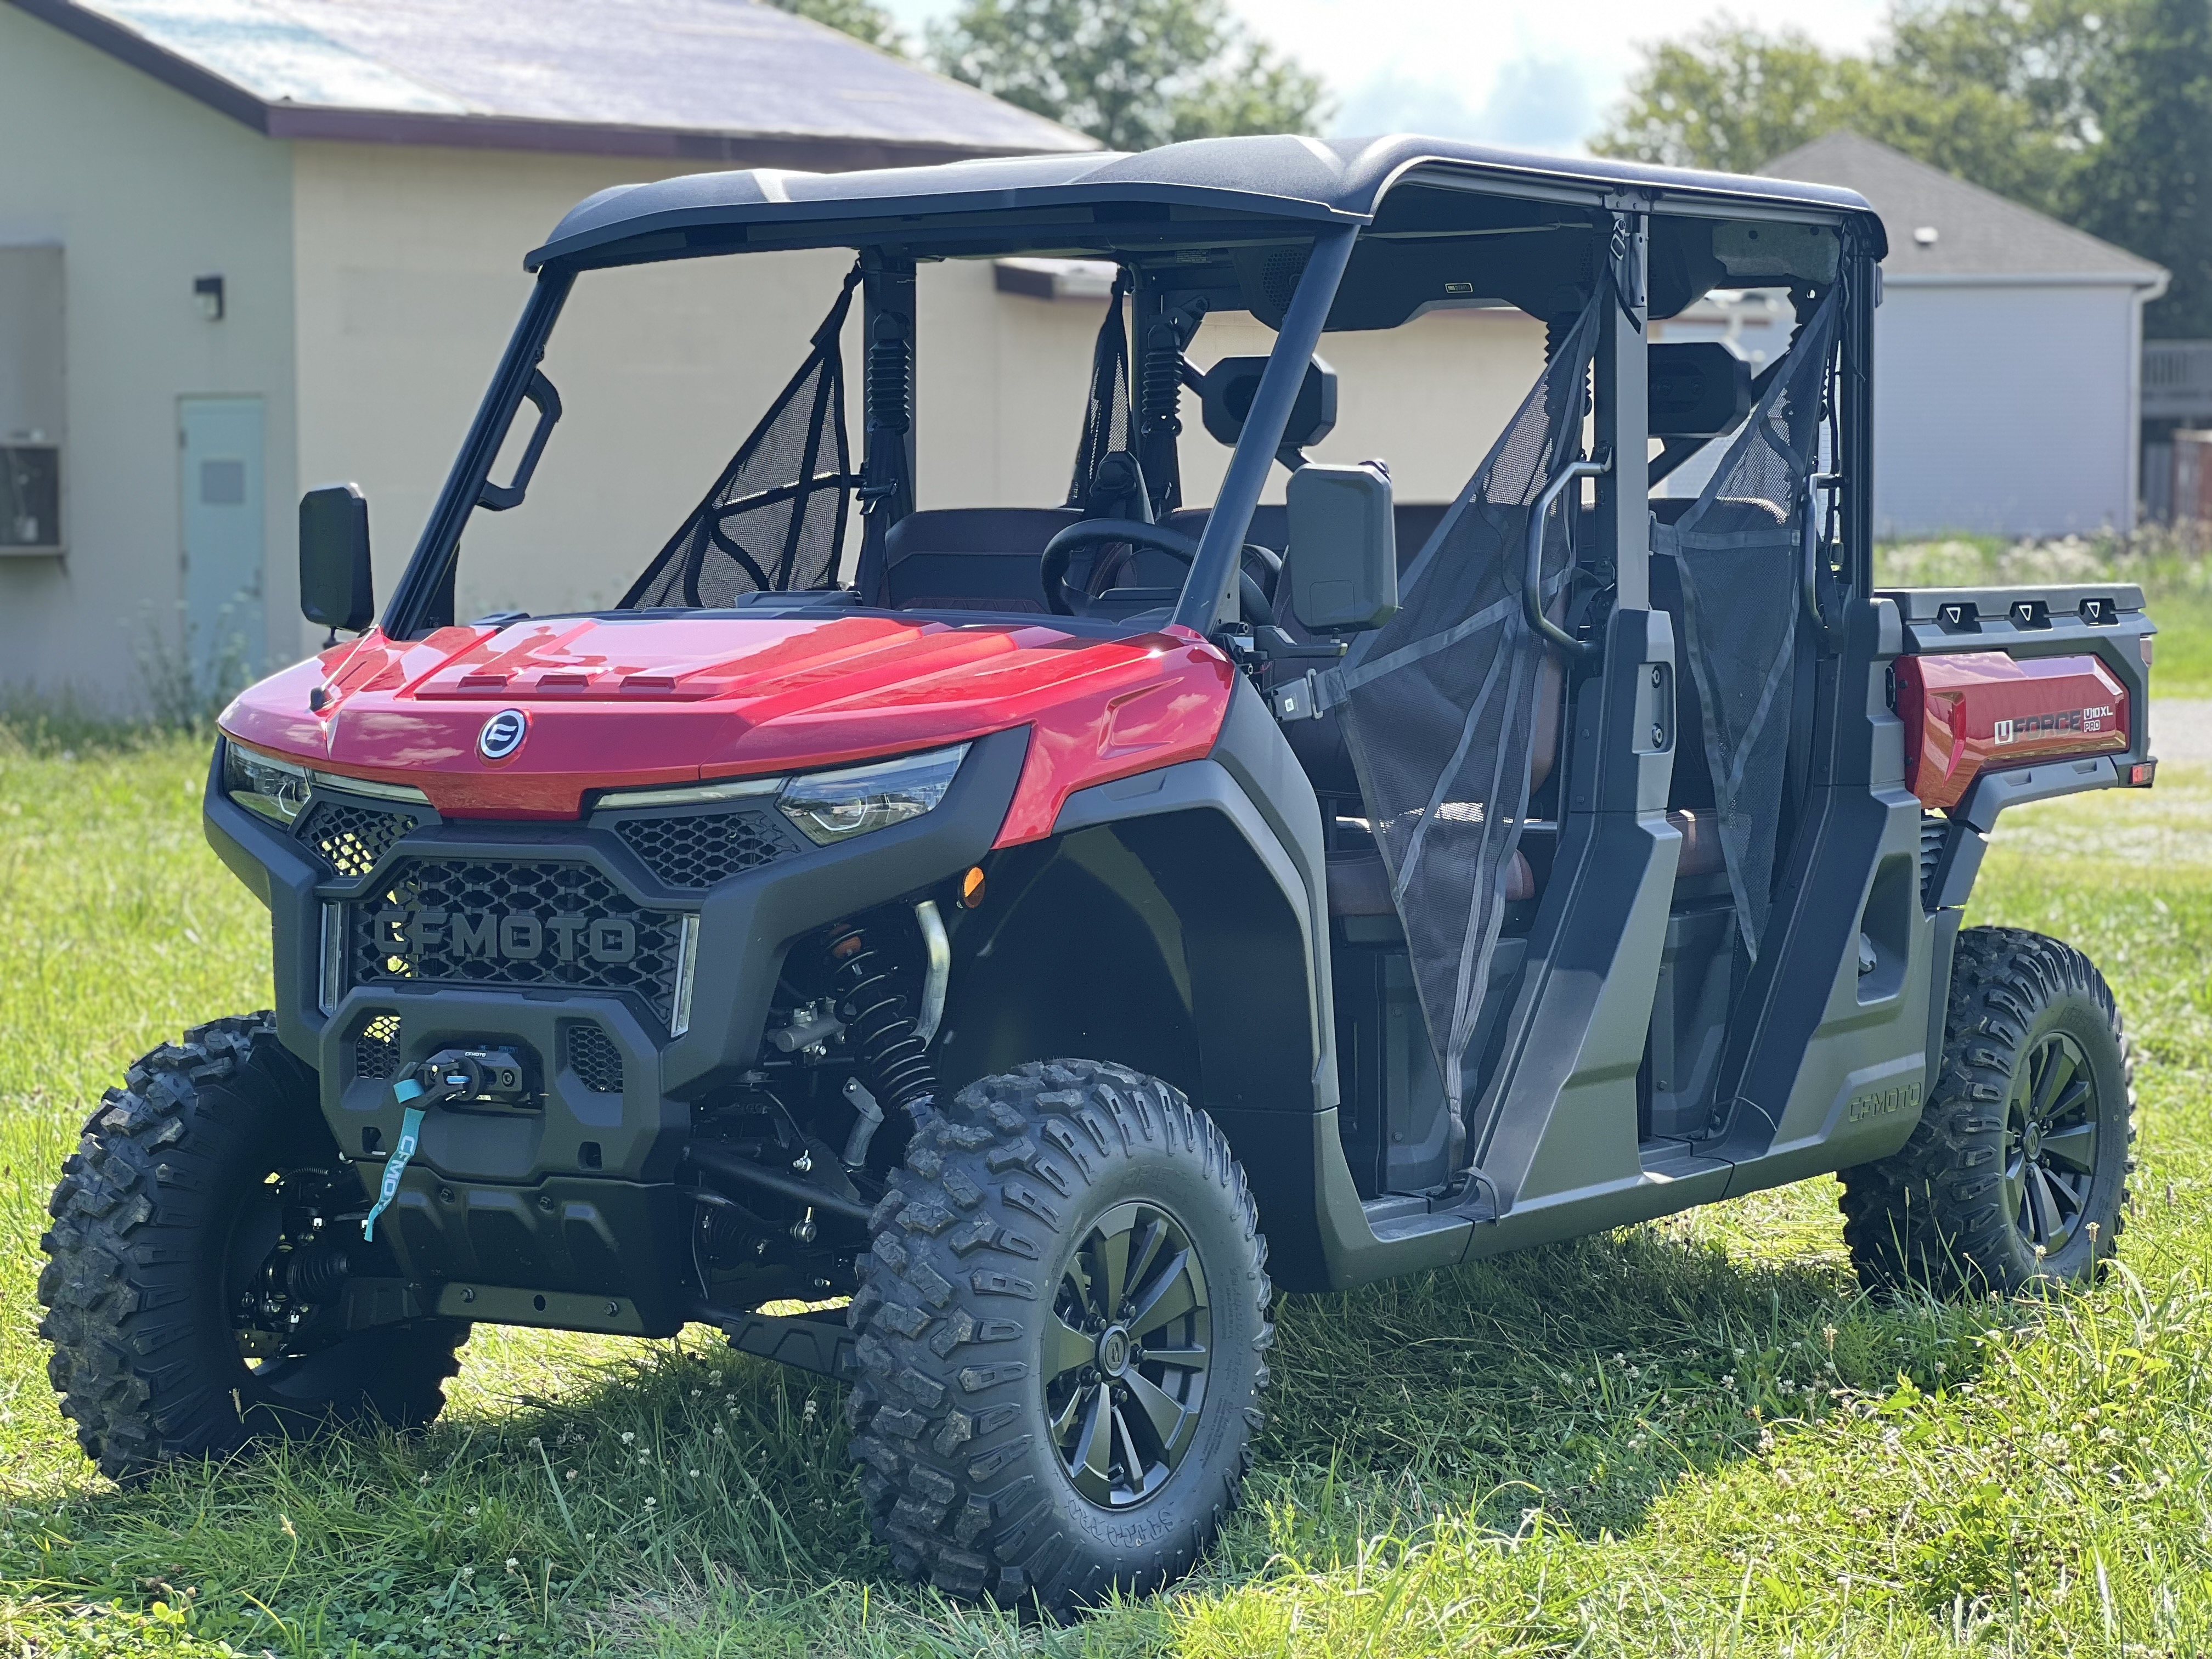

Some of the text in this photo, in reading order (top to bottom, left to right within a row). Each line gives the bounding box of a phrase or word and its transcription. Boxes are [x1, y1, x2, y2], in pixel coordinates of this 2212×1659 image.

[2084, 719, 2101, 732] PRO
[374, 909, 636, 963] CFMOTO
[1849, 1081, 1922, 1122] CFMOTO
